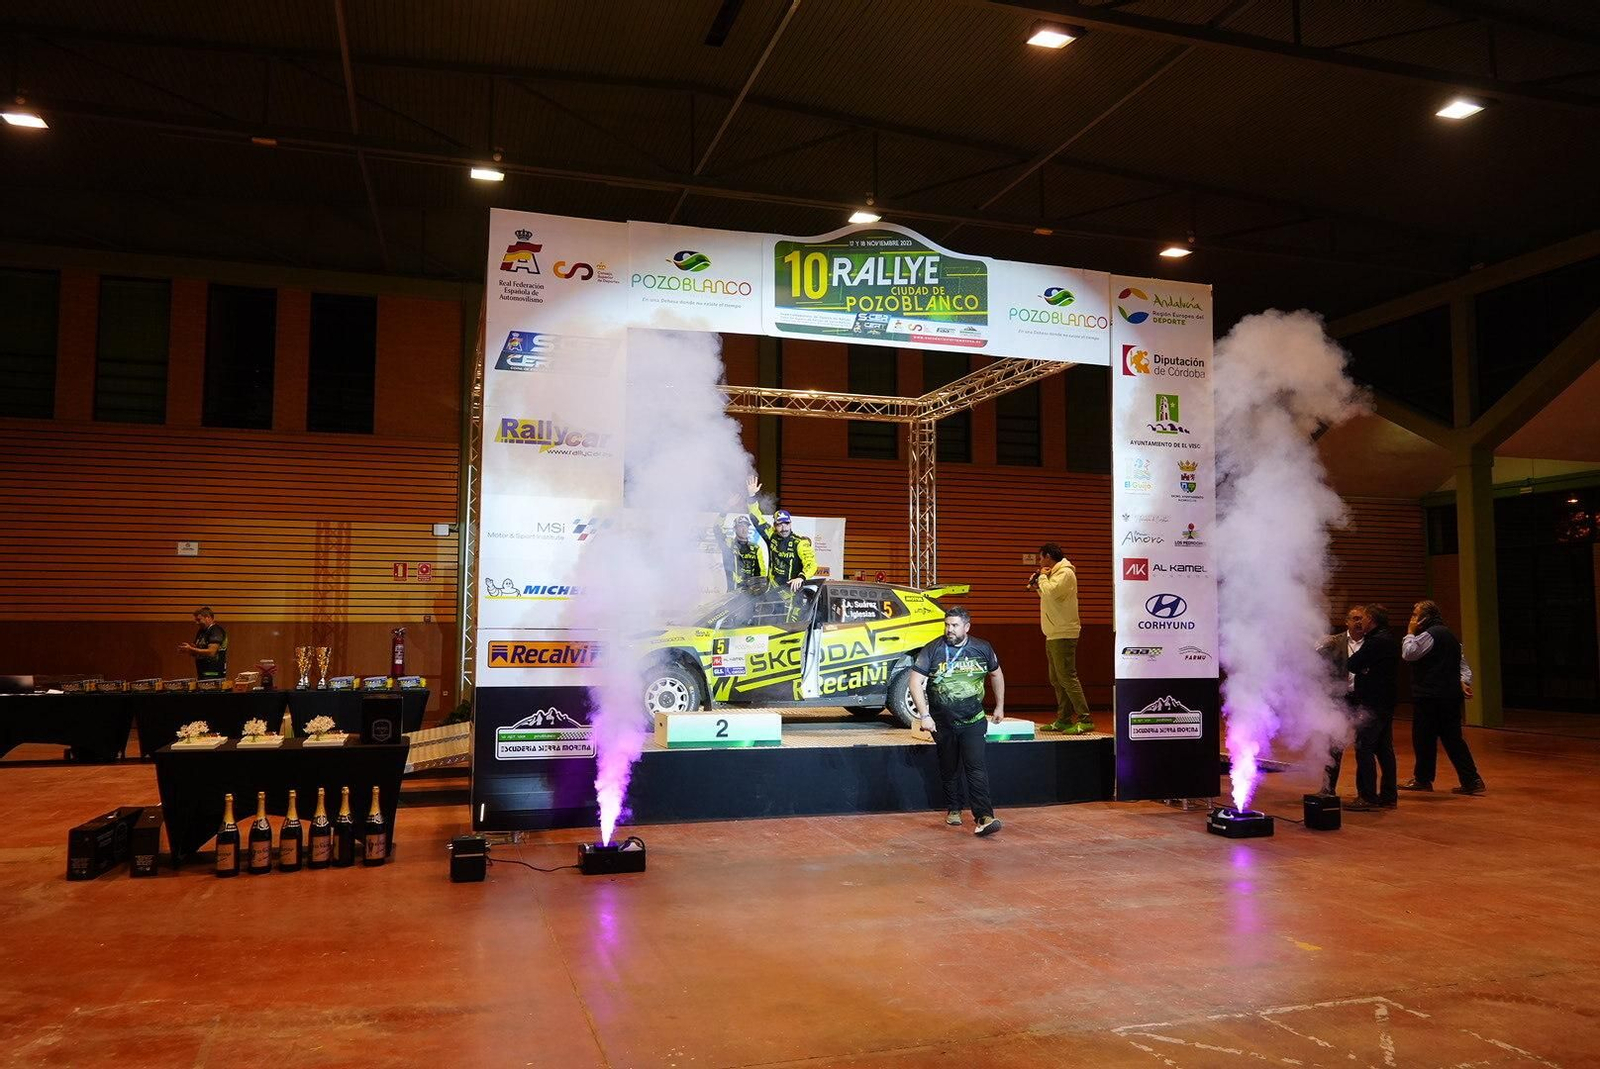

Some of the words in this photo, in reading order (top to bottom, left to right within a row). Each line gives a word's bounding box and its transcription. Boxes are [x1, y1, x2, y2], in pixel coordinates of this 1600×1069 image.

[784, 250, 828, 300] 10
[832, 256, 940, 286] RALLYE
[512, 281, 544, 290] Federación
[632, 274, 752, 296] POZOBLANCO
[504, 287, 531, 296] Española
[890, 286, 928, 296] CIUDAD
[932, 286, 946, 296] DE
[499, 294, 544, 303] Automovilismo
[846, 294, 980, 312] POZOBLANCO
[1153, 294, 1204, 311] Andalucía
[1009, 308, 1108, 330] POZOBLANCO
[1153, 318, 1186, 326] DEPORTE
[1154, 354, 1205, 368] Diputación
[1154, 366, 1166, 376] de
[1168, 366, 1206, 378] Córdoba
[1130, 440, 1172, 448] AYUNTAMIENTO
[536, 522, 565, 533] MSi
[1152, 564, 1167, 572] AL
[850, 610, 876, 618] Iglesias
[854, 600, 877, 609] Suárez
[883, 601, 893, 618] 5
[1138, 622, 1195, 630] CORHYUND
[716, 639, 726, 654] 5
[510, 645, 588, 664] Recalvi
[716, 719, 729, 738] 2
[562, 744, 591, 752] MORENA
